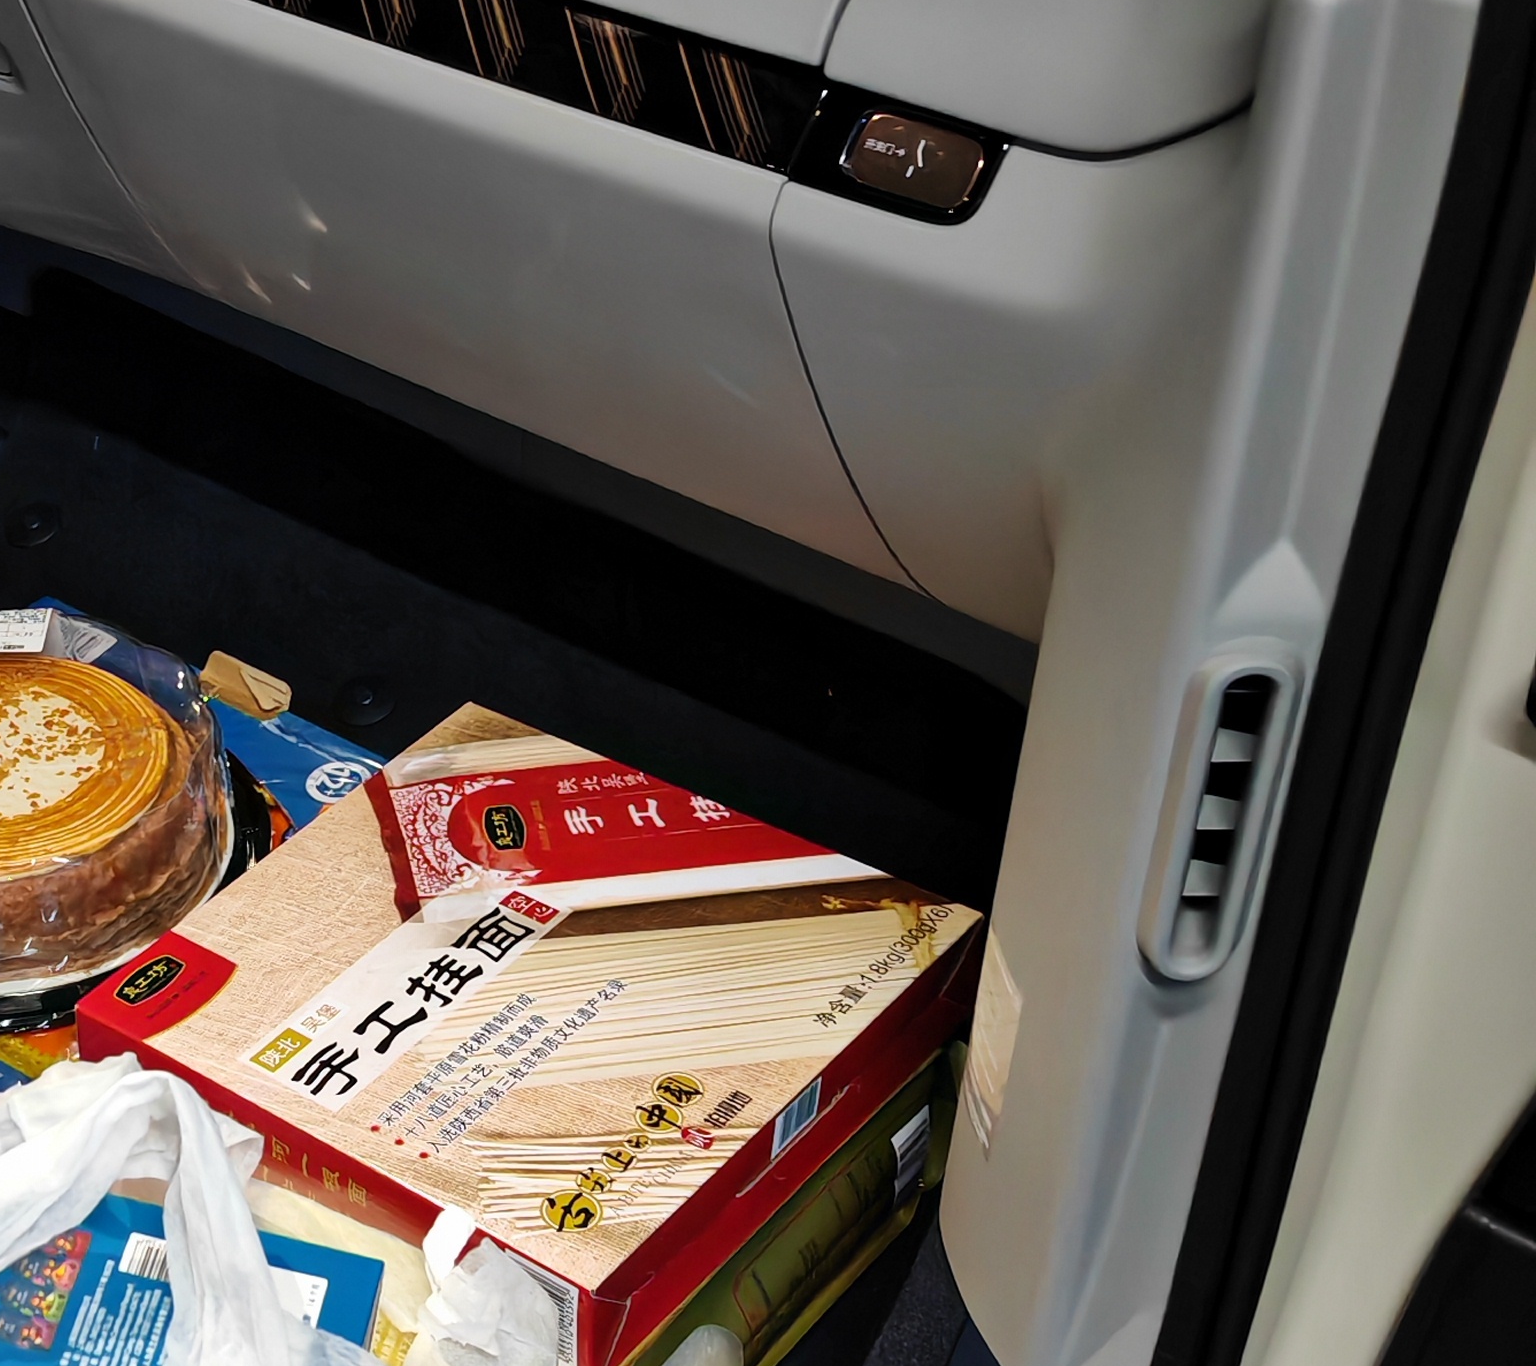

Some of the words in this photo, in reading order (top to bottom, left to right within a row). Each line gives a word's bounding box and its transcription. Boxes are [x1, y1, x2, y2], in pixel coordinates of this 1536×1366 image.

[259, 1037, 301, 1068] 陕北
[291, 906, 536, 1096] 手工挂面
